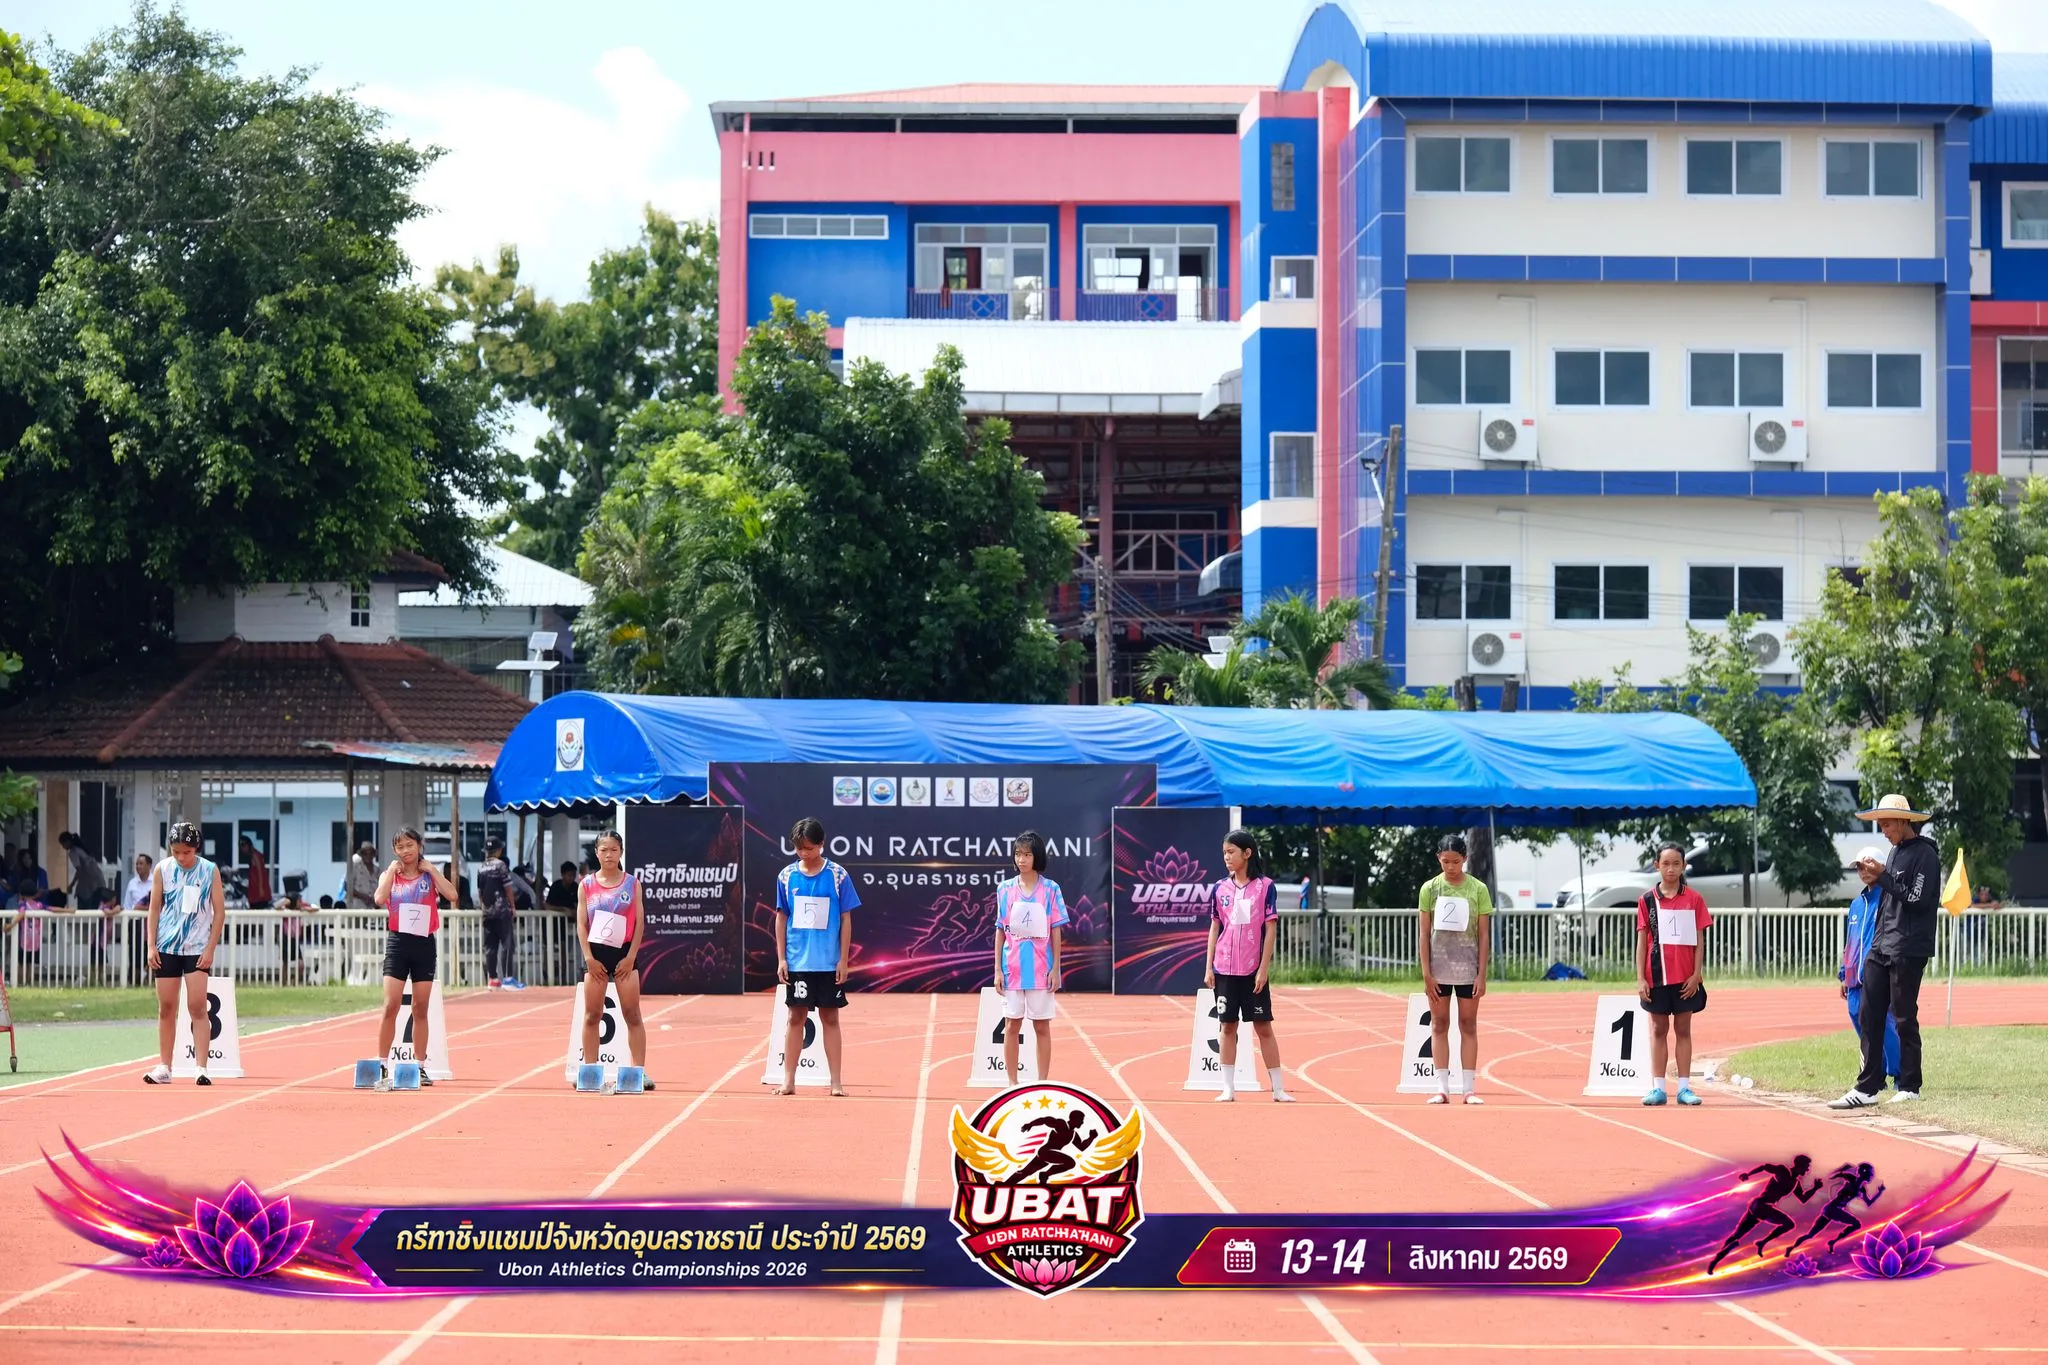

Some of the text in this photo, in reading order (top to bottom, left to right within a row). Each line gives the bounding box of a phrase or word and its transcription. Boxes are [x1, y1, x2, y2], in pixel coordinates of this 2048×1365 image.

[780, 835, 1091, 858] UON RATCHATANI
[863, 867, 1005, 891] จ.อุบลราชธานี
[645, 884, 723, 902] จ.อุบลราชธานี
[1131, 883, 1215, 903] UBON
[803, 902, 818, 925] 5
[1133, 903, 1211, 914] ATHLETICS
[1442, 902, 1459, 924] 2
[409, 909, 421, 927] 7
[673, 913, 702, 924] สิงหาคม
[704, 914, 724, 924] 2569
[1021, 910, 1032, 927] 4
[1668, 915, 1680, 936] 1
[601, 917, 613, 938] 6
[793, 981, 808, 998] 16
[1611, 1010, 1635, 1061] 1
[186, 1044, 223, 1059] Nco
[987, 1056, 1025, 1071] Neo
[1413, 1062, 1451, 1077] Nel
